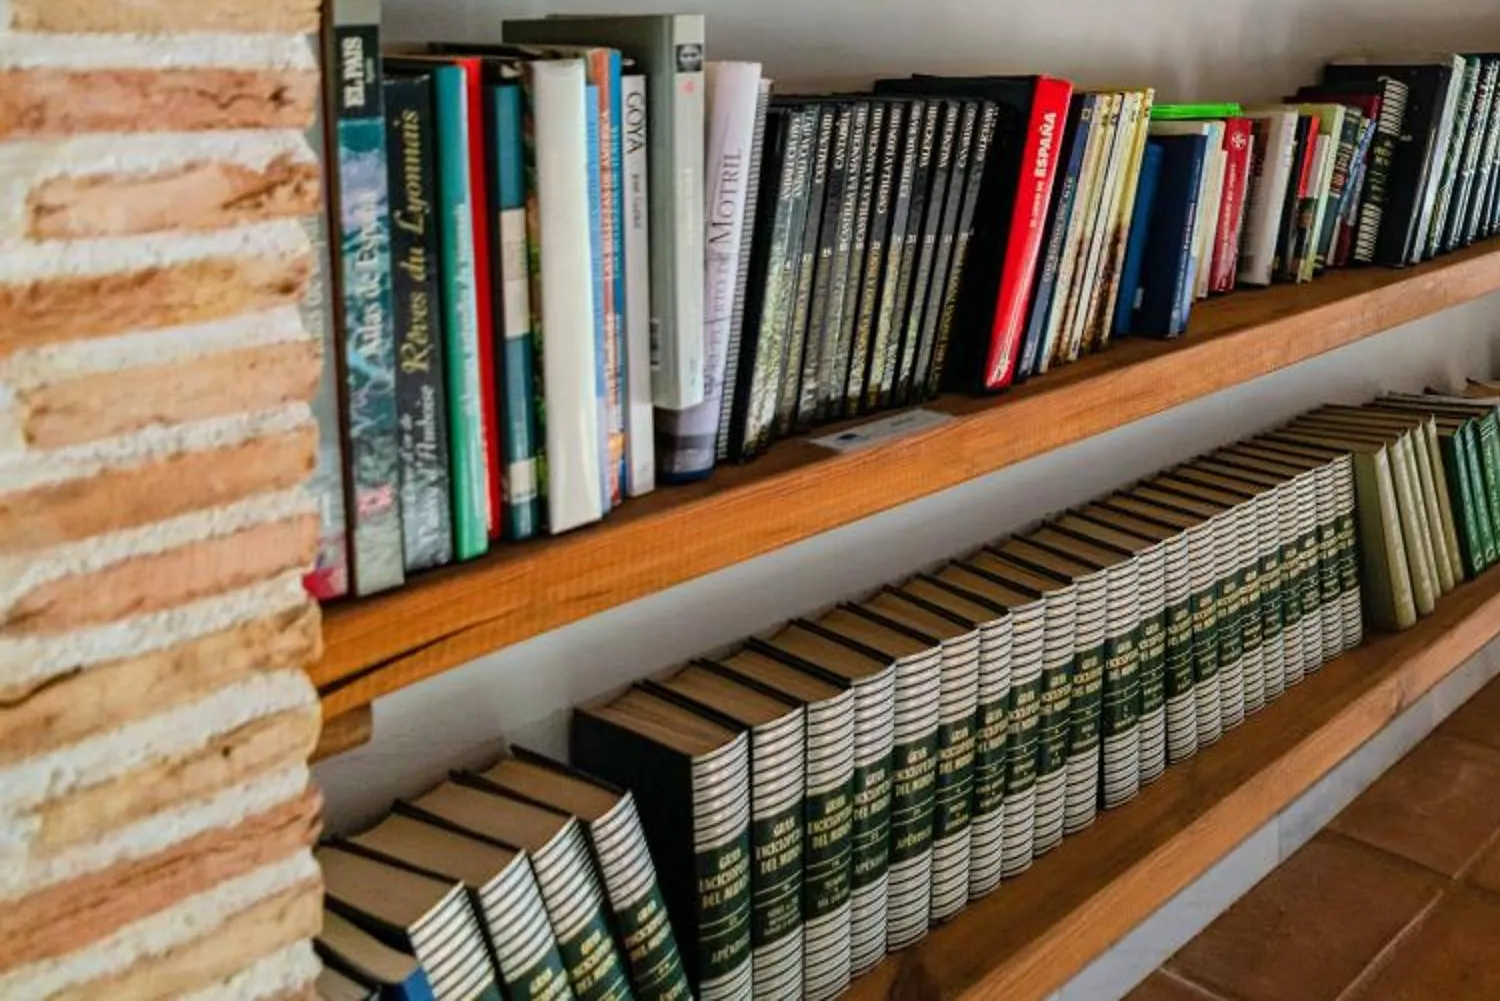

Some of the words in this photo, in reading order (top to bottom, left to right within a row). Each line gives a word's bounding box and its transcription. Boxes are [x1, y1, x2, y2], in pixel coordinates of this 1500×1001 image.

[393, 108, 430, 235] Lyonnais
[1033, 111, 1057, 178] ESPAÑA
[708, 146, 744, 245] MOTRIL
[400, 246, 428, 282] du
